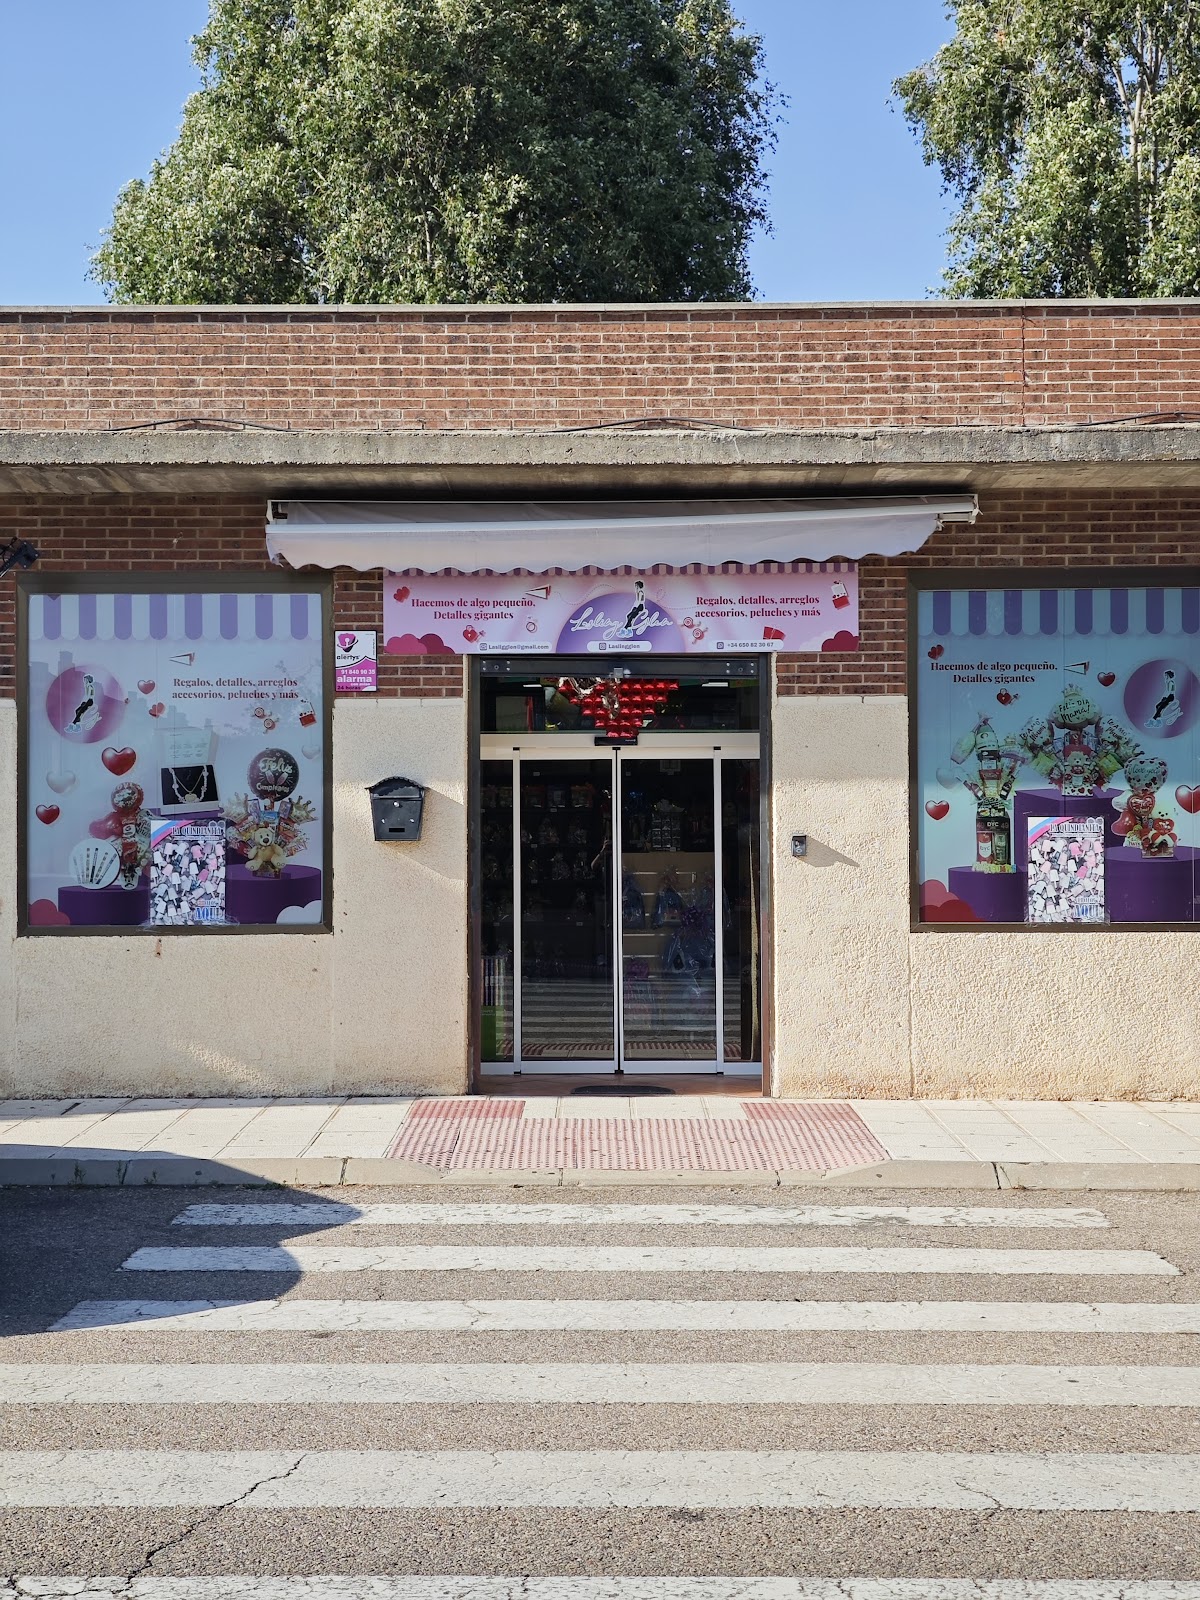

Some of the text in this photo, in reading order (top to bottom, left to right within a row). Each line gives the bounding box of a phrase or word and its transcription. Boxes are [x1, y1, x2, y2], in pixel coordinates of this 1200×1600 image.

[411, 598, 455, 608] Hacemos
[456, 598, 469, 608] de
[470, 598, 490, 610] algo
[779, 595, 820, 606] arreglos
[433, 610, 514, 621] Detalles gigantes
[750, 607, 792, 619] peluches
[793, 609, 800, 618] y
[801, 607, 821, 617] más
[930, 661, 975, 671] Hacemos
[976, 661, 988, 671] de
[990, 661, 1012, 673] algo
[257, 677, 298, 688] arreglos
[953, 673, 1036, 685] Detalles gigantes
[227, 689, 270, 701] peluches
[271, 691, 278, 700] y
[279, 688, 299, 699] más
